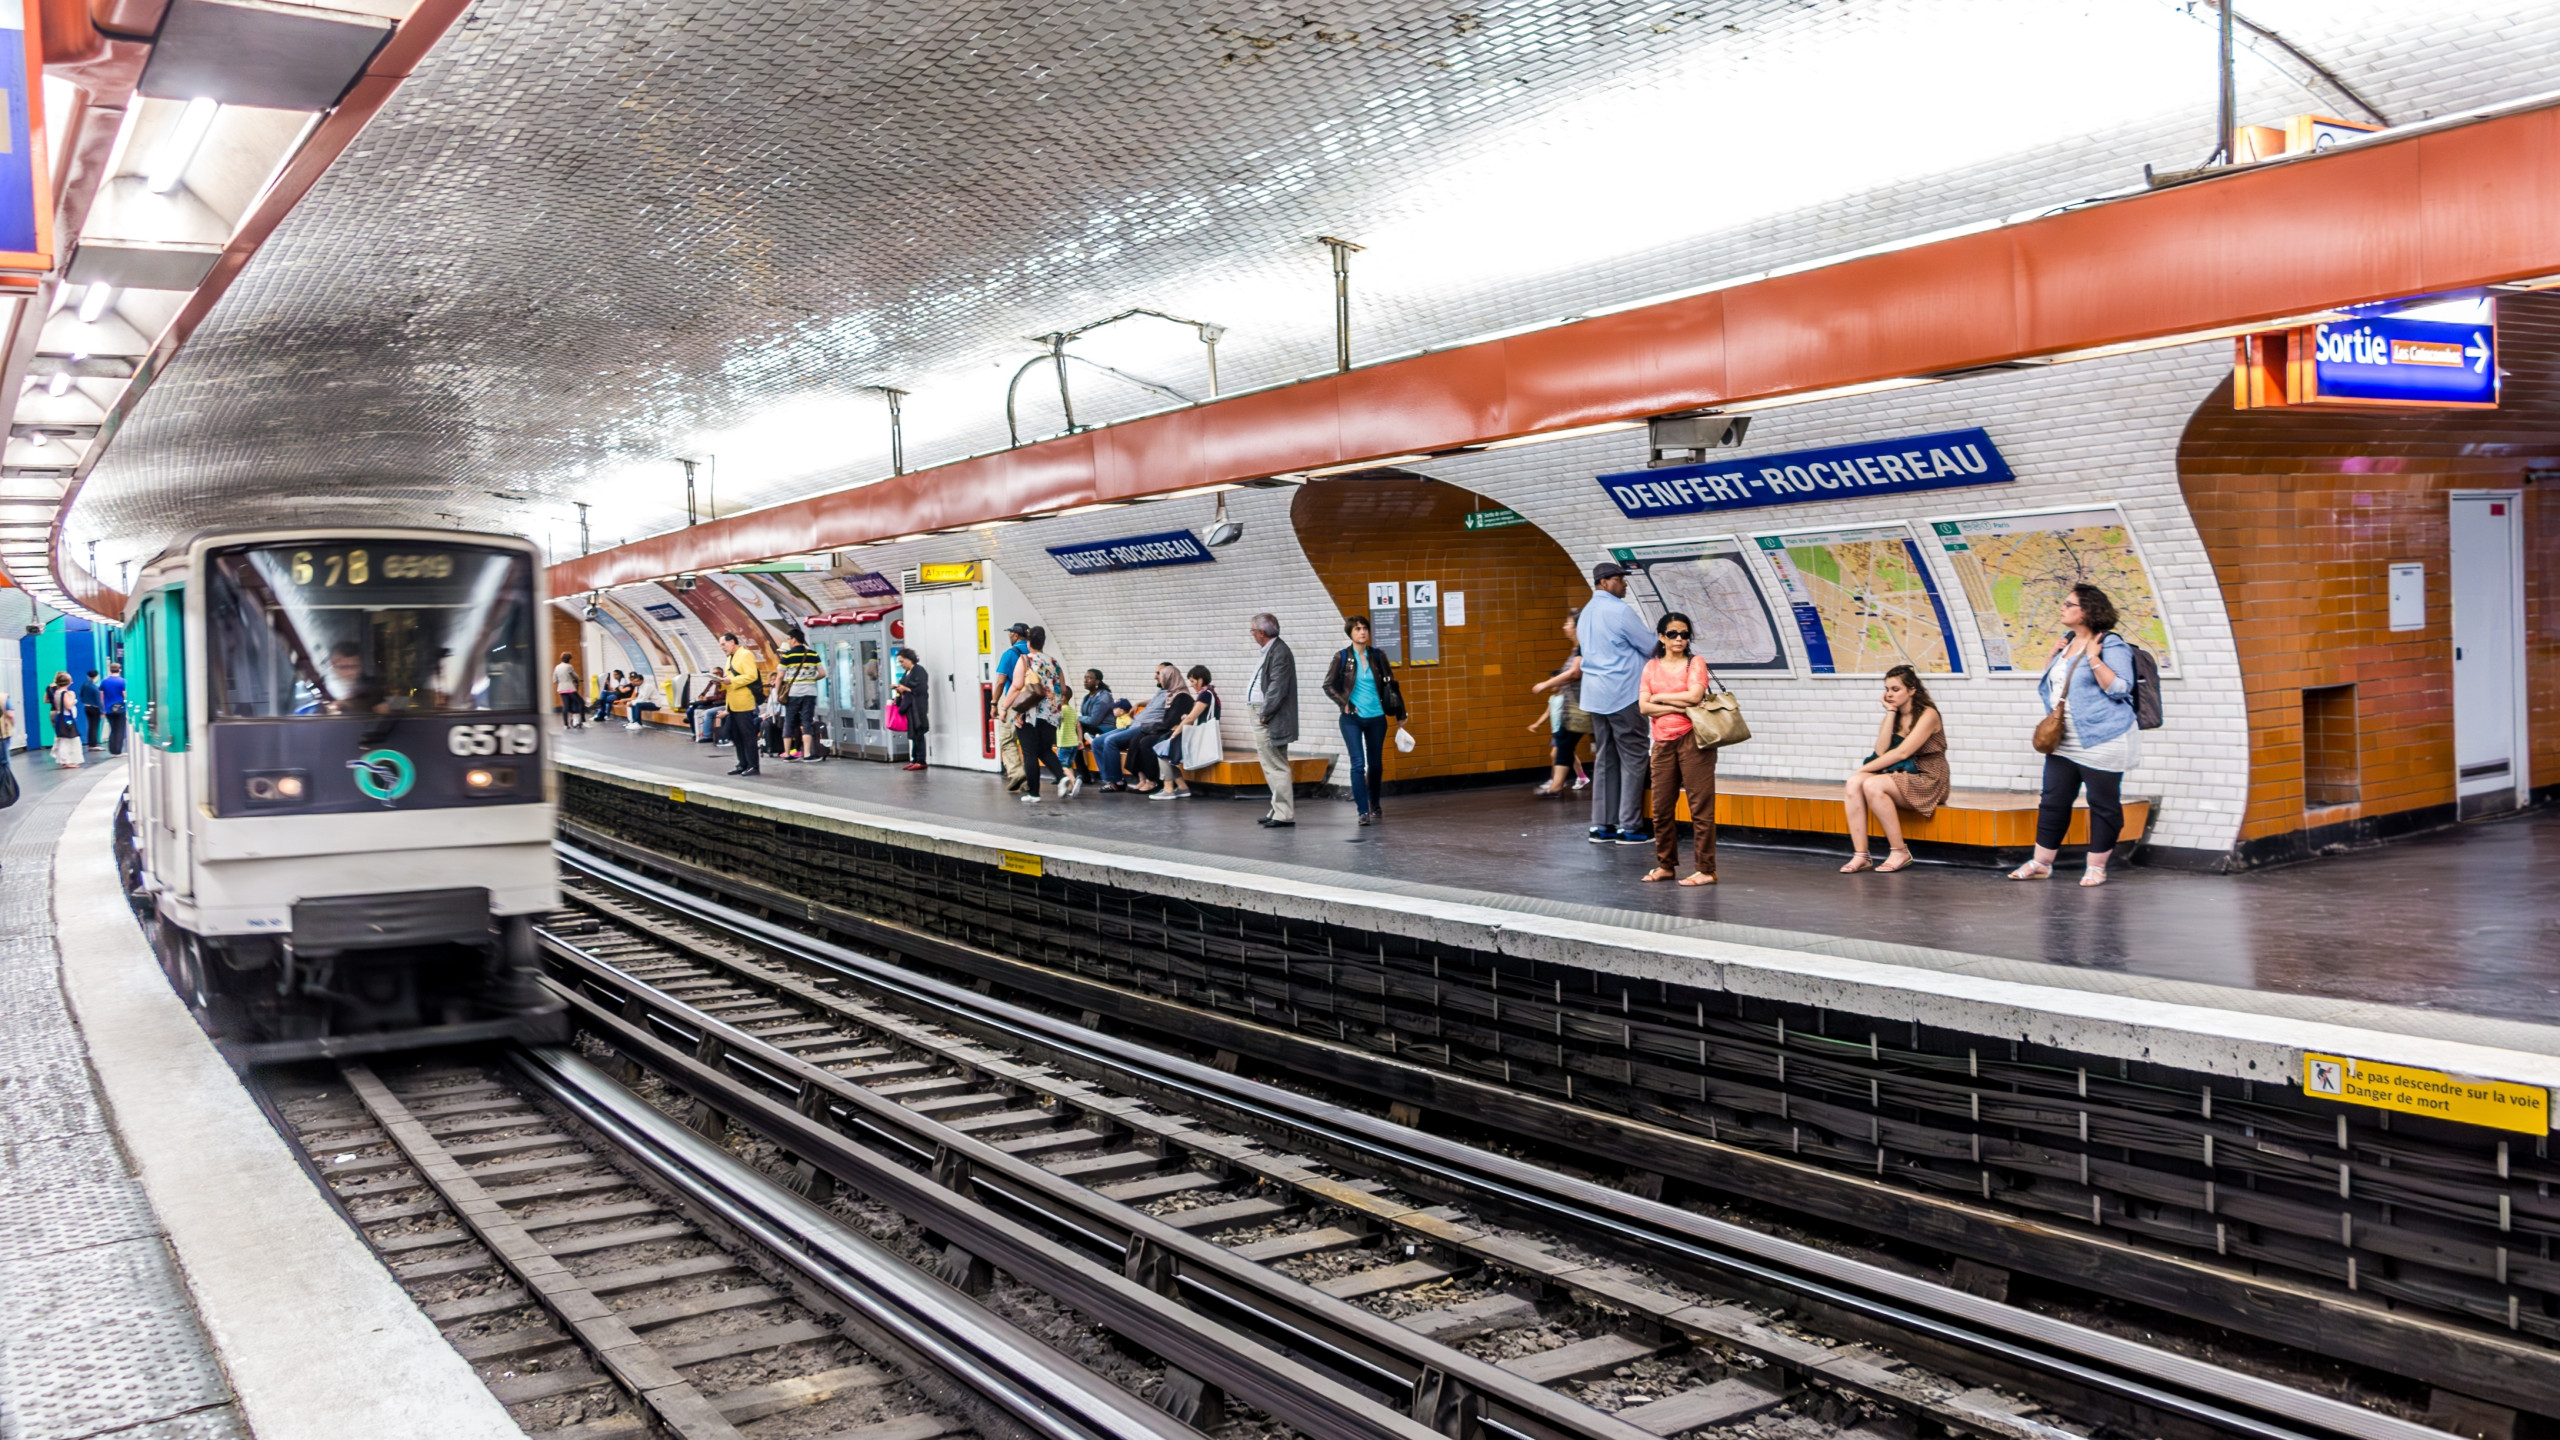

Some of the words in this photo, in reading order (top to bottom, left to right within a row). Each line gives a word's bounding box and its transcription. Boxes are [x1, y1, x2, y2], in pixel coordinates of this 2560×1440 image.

[2316, 324, 2388, 366] Sortie
[1612, 443, 1989, 510] DENFERT-ROCHEREAU
[1054, 538, 1200, 570] DENFERT-ROCHEREAU
[925, 568, 960, 578] Alarme
[448, 724, 538, 757] 6519
[2346, 1083, 2392, 1102] Danger
[2396, 1092, 2413, 1105] de
[2417, 1098, 2450, 1112] mort
[2367, 1073, 2390, 1086] pas
[2394, 1075, 2463, 1097] descendre
[2467, 1089, 2488, 1101] sur
[2493, 1090, 2506, 1104] la
[2510, 1092, 2541, 1110] voie
